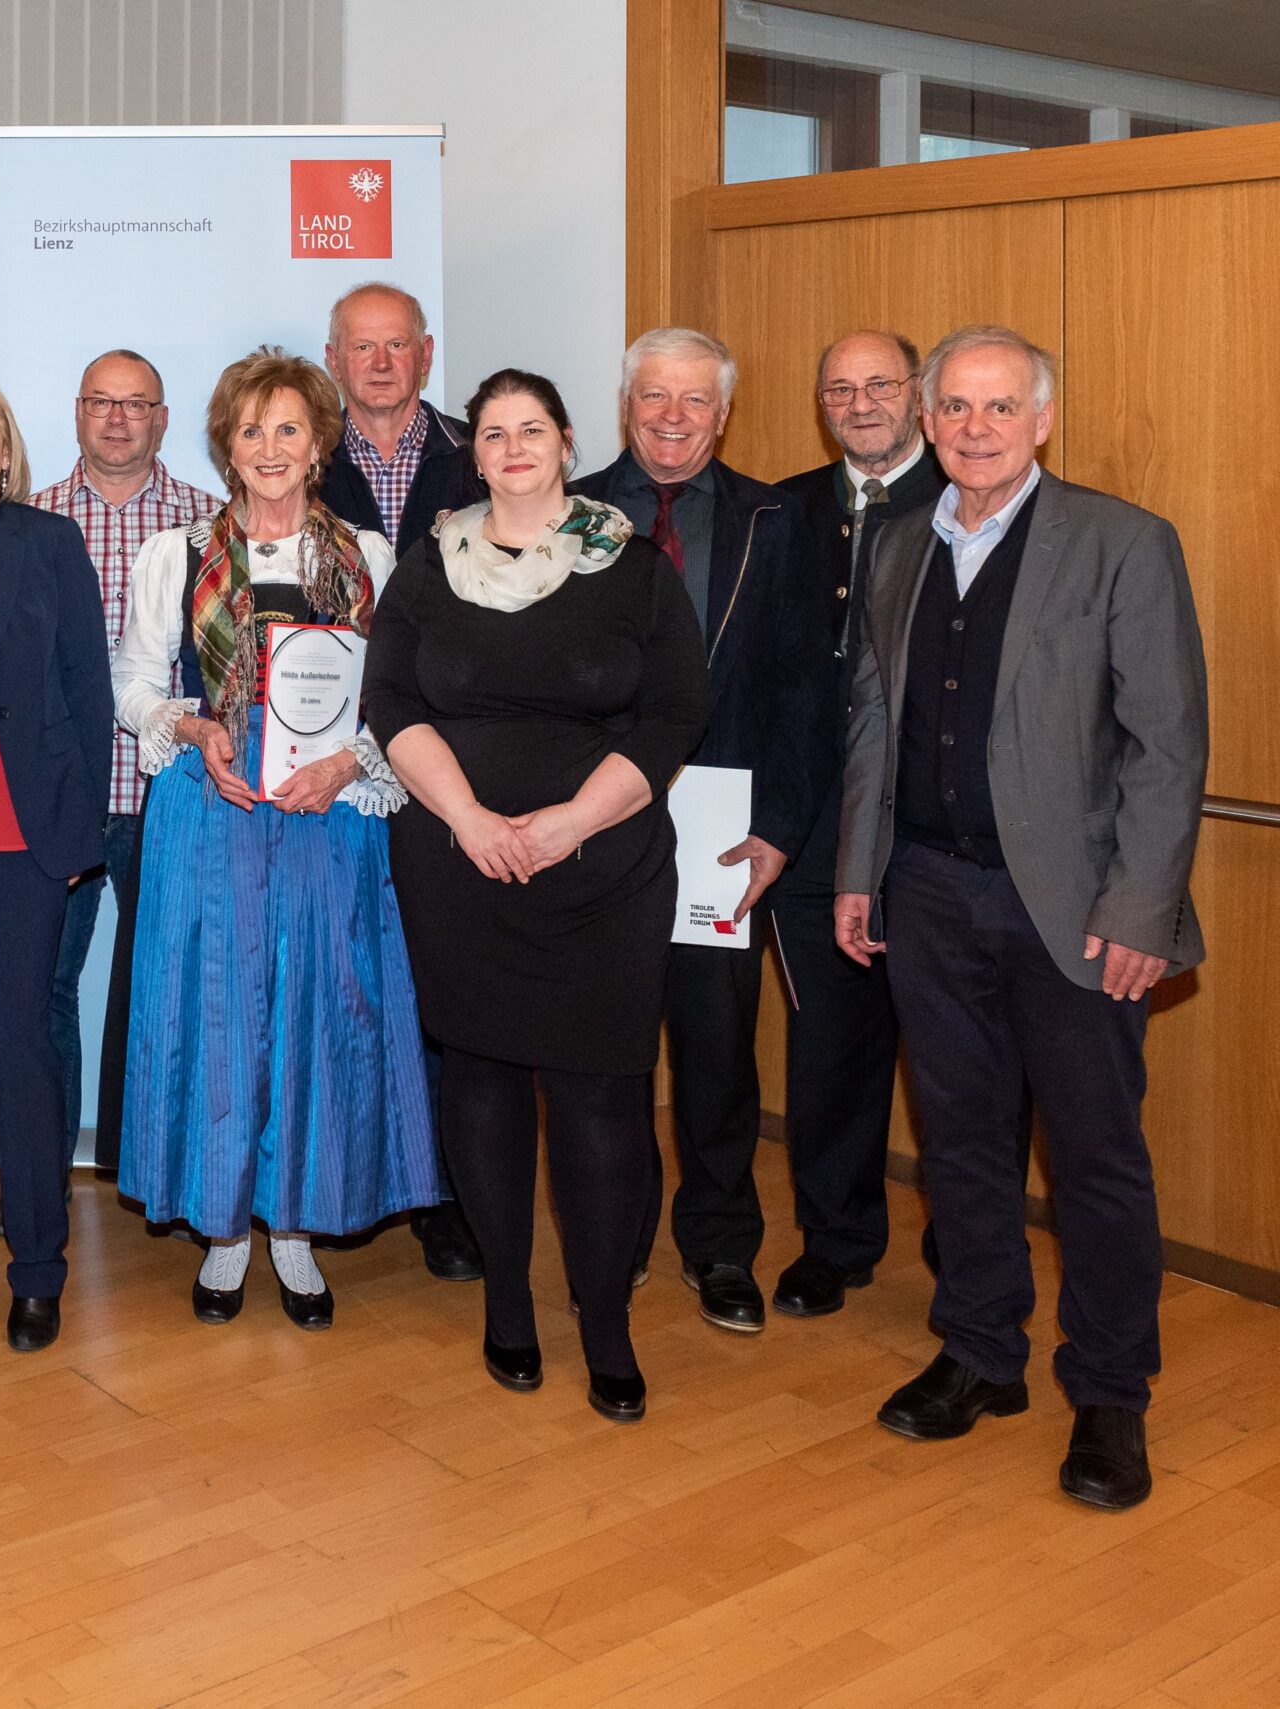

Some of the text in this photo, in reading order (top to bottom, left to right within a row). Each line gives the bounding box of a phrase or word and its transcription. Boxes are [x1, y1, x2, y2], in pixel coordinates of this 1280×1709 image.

[34, 218, 213, 235] Bezirkshauptmannschaft
[300, 215, 352, 231] LAND
[34, 236, 74, 250] Lienz
[299, 233, 355, 250] TIROL
